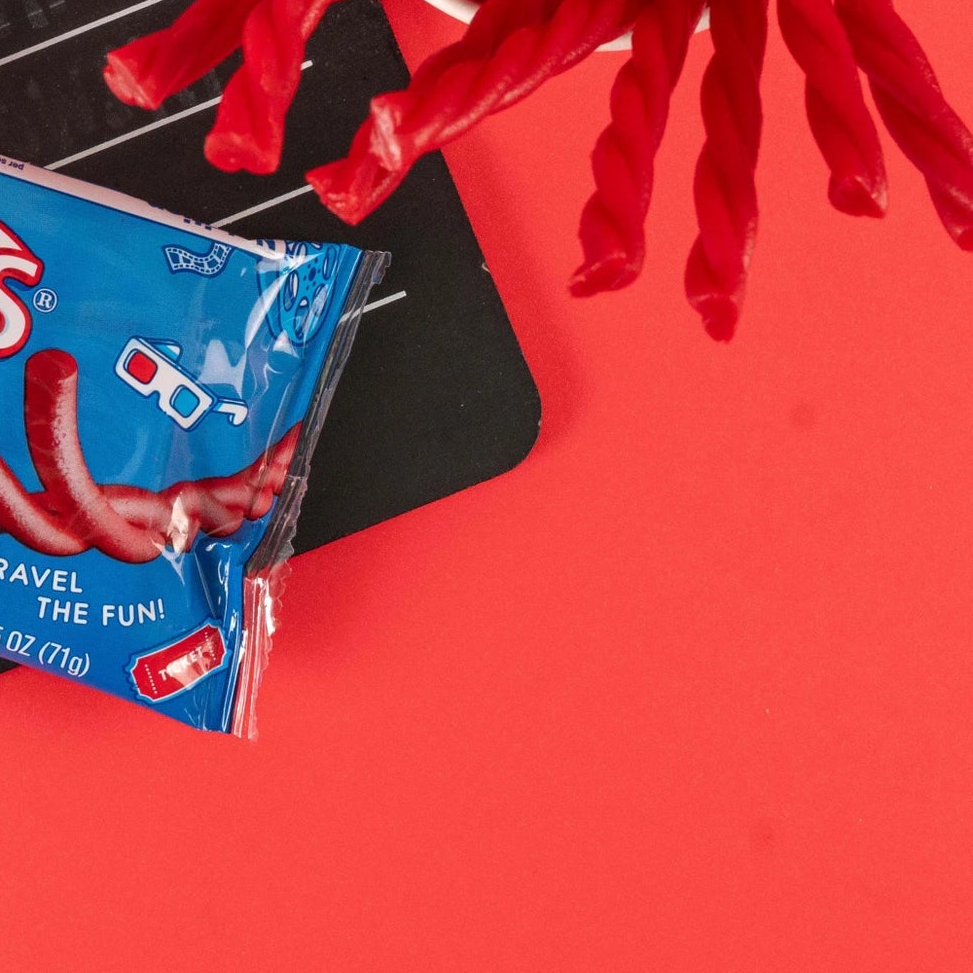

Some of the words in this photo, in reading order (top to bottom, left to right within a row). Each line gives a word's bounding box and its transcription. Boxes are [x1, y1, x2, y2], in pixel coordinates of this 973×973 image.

[8, 159, 25, 171] per
[37, 596, 89, 625] THE
[102, 598, 165, 626] FUN!
[6, 630, 36, 657] OZ
[38, 641, 90, 677] (71g)
